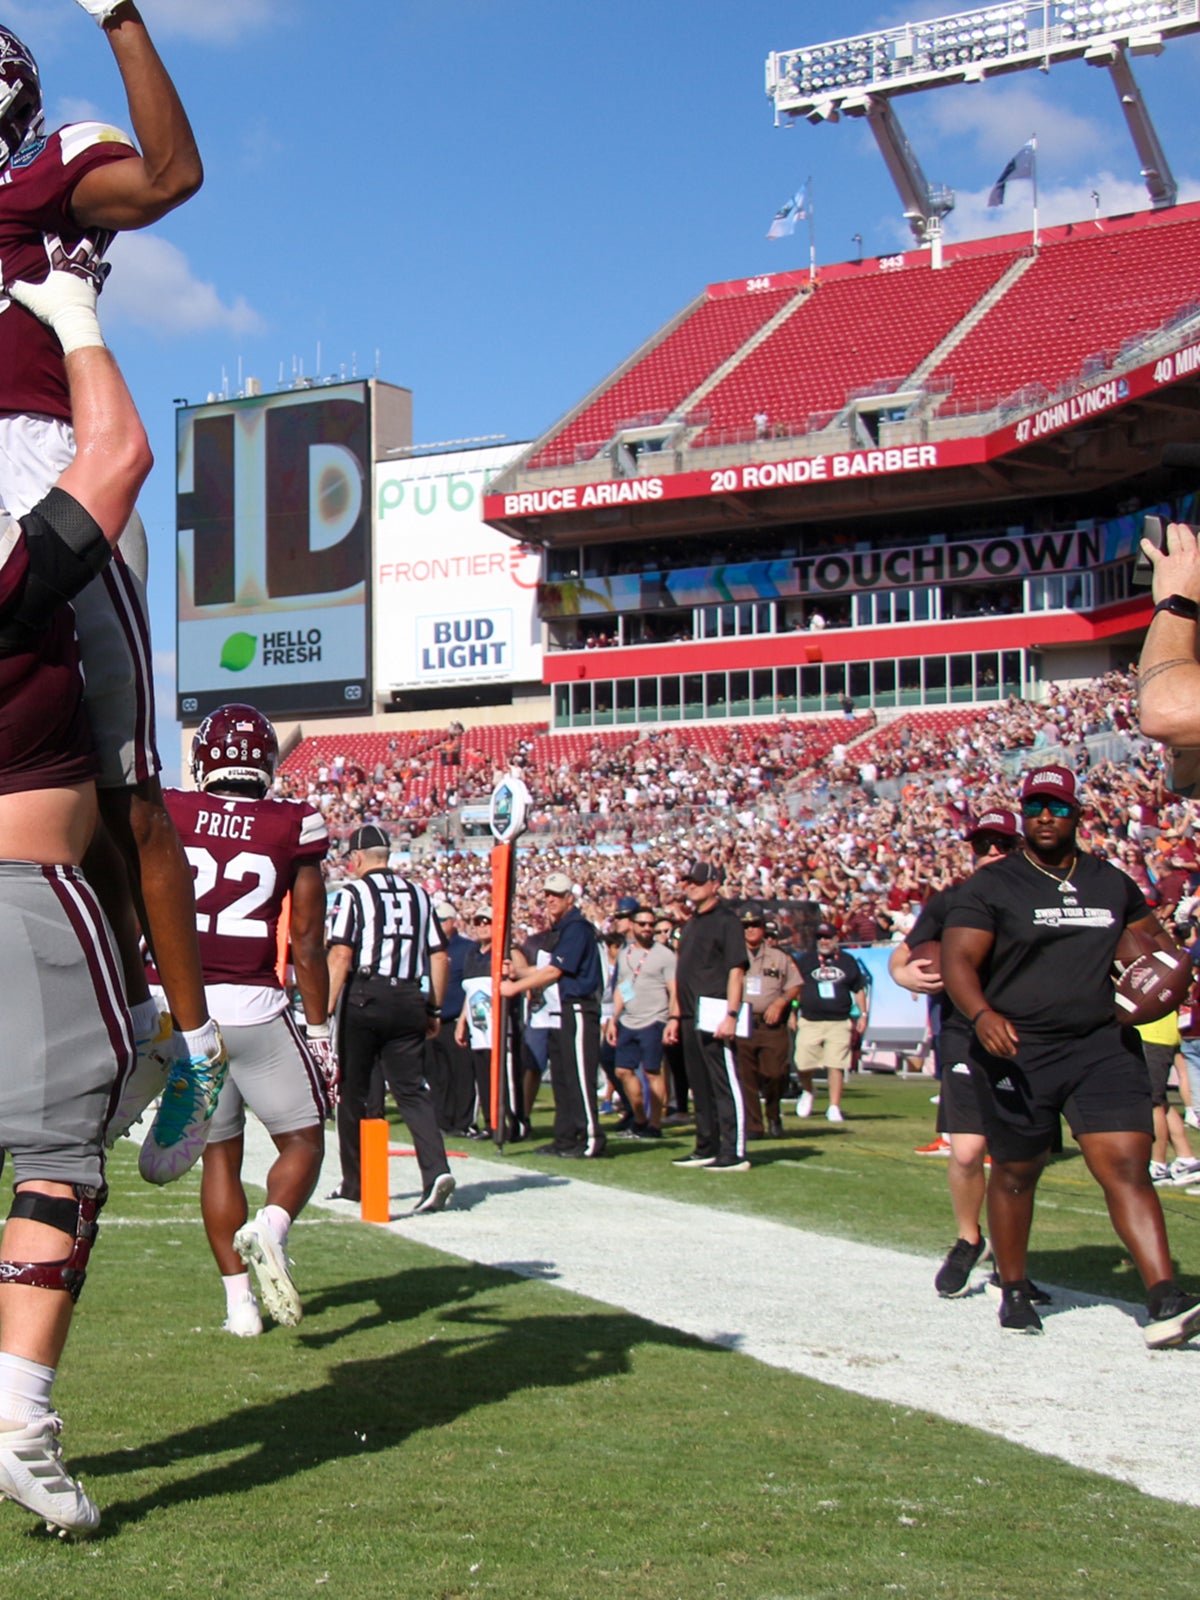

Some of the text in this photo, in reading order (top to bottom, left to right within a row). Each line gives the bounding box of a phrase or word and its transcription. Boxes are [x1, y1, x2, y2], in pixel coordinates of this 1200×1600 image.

[1152, 357, 1172, 384] 40
[1015, 380, 1117, 443] 47 JOHN LYNCH
[710, 445, 937, 492] 20 RONDÉ BARBER
[504, 478, 664, 515] BRUCE ARIANS
[378, 552, 507, 586] FRONTIER
[792, 530, 1100, 593] TOUCHDOWN
[262, 628, 322, 650] HELLO
[433, 617, 495, 645] BUD
[262, 645, 323, 667] FRESH
[421, 642, 507, 671] LIGHT
[194, 810, 256, 841] PRICE
[183, 846, 278, 938] 22
[379, 891, 415, 936] H
